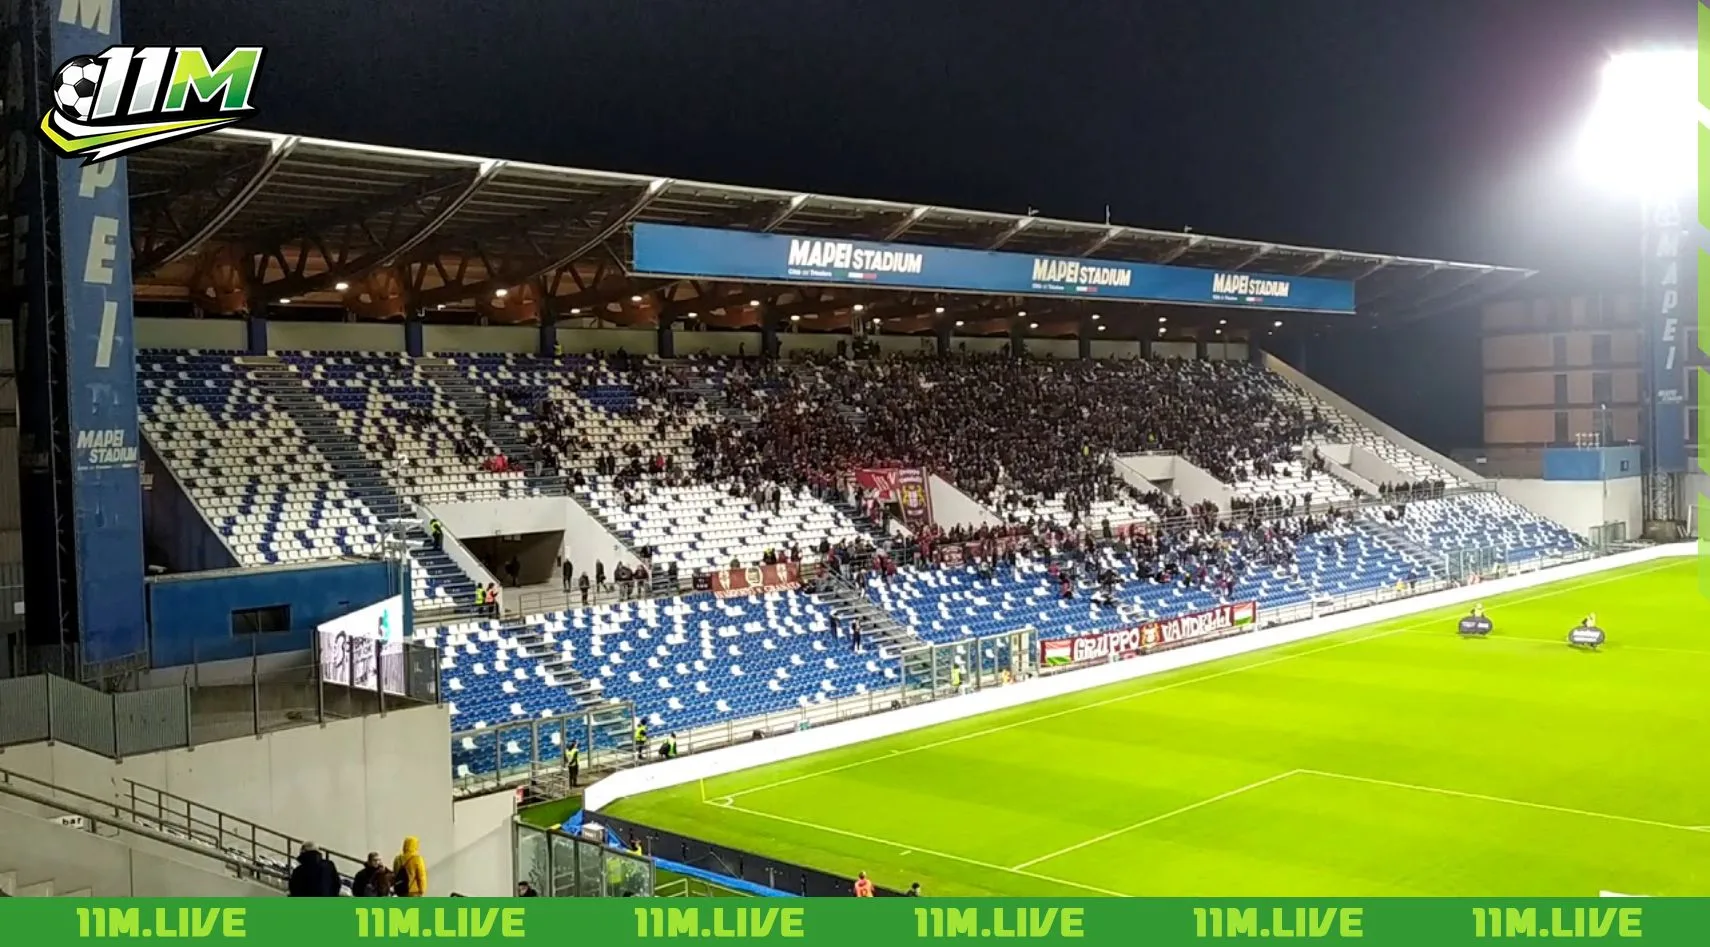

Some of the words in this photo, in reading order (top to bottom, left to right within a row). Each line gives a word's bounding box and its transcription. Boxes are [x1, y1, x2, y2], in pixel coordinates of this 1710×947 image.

[788, 239, 853, 268] MAPEI
[852, 249, 923, 273] STADIUM
[1032, 258, 1080, 284] MAPEI
[1079, 266, 1132, 286] STADIUM
[1212, 273, 1250, 294] MAPEI
[1248, 279, 1291, 297] STADIUM
[77, 429, 125, 449] MAPEI
[89, 447, 138, 464] STADIUM
[1072, 627, 1140, 662] GRUPPO
[1161, 605, 1233, 643] VANDELLI
[61, 816, 83, 826] bar
